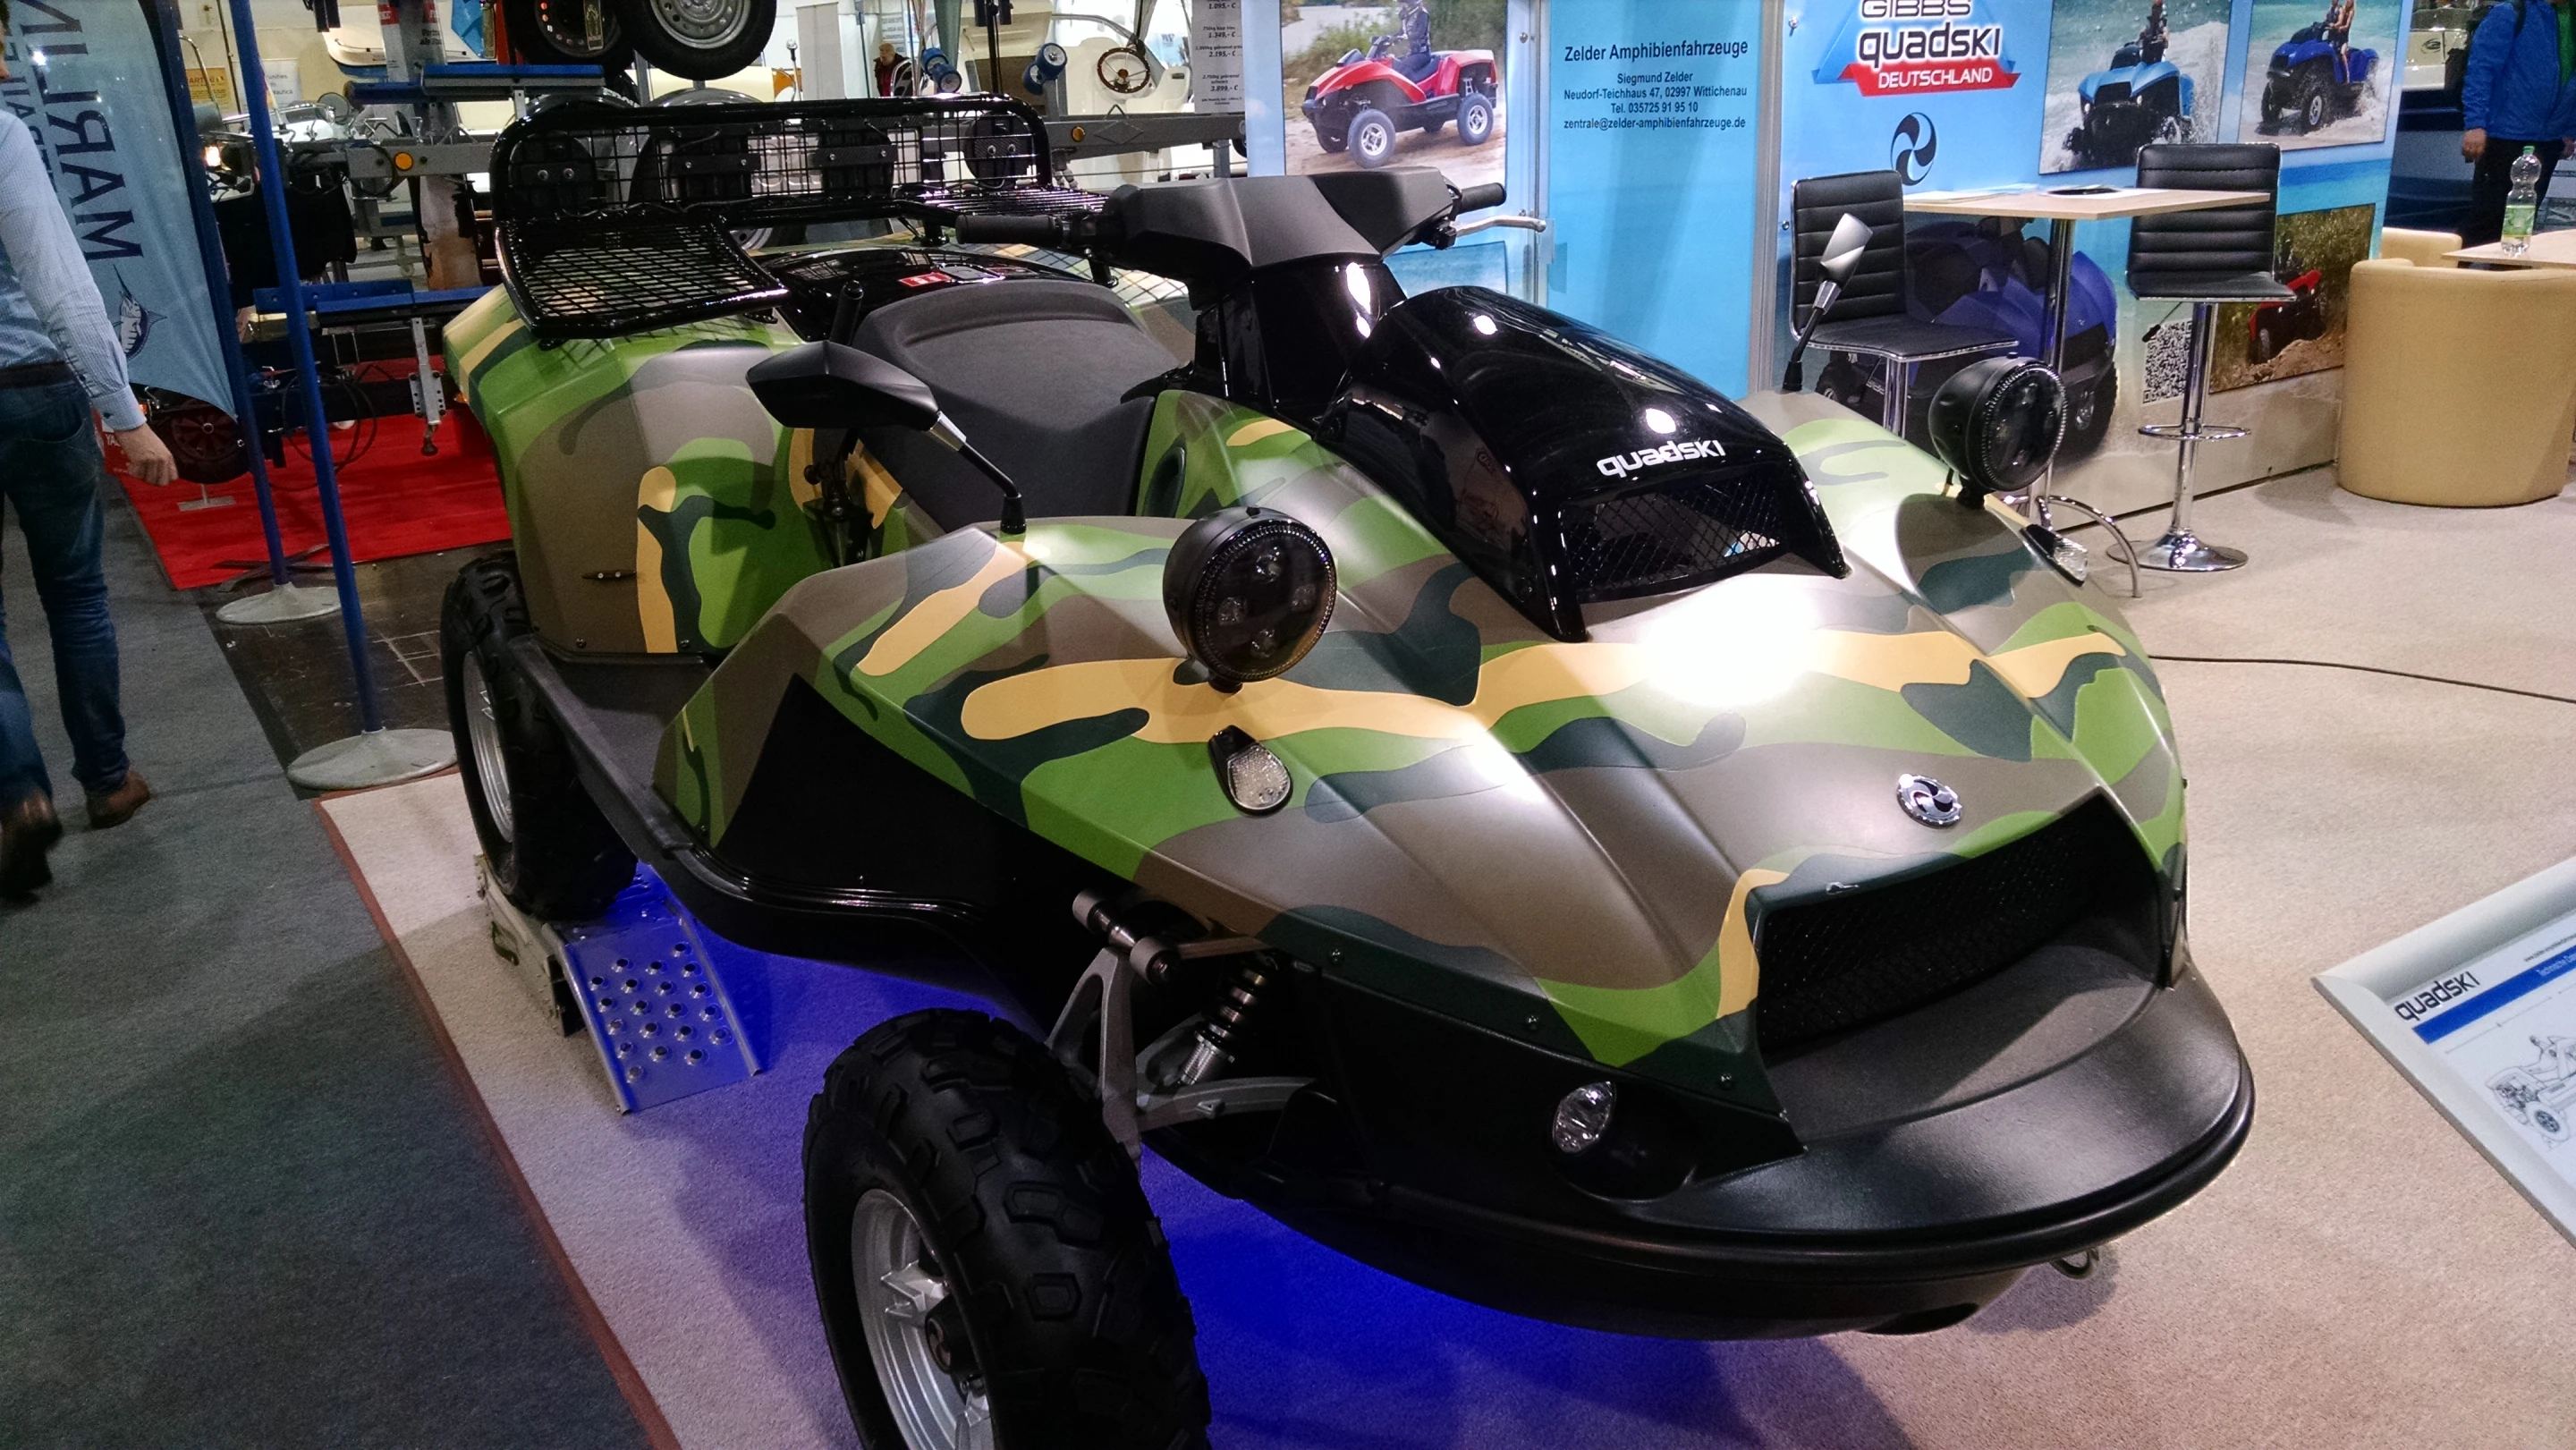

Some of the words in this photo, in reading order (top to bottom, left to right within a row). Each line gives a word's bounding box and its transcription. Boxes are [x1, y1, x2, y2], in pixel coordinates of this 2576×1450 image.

[1861, 0, 1970, 18] GIBBS
[1564, 46, 1606, 62] Zelder
[1610, 40, 1749, 63] Amphibienfahrzeuge
[1859, 22, 2001, 69] quadski
[1617, 72, 1662, 85] Siegmund
[1664, 72, 1693, 82] Zelder
[1878, 67, 1993, 89] DEUTSCHLAND
[1564, 89, 1647, 99] Neudorf-Teichhaus
[1649, 88, 1663, 99] 47,
[1665, 87, 1690, 98] 02997
[1693, 86, 1747, 97] Wittichenau
[1611, 103, 1626, 114] Tel.
[1628, 102, 1659, 114] 035725
[1661, 102, 1672, 113] 91
[1674, 102, 1686, 113] 95
[1688, 101, 1699, 112] 10
[1563, 117, 1746, 131] zentrale@zelder-amphibienfahrzeuge.de
[1596, 439, 1726, 479] quadski
[2394, 971, 2481, 1022] quadski
